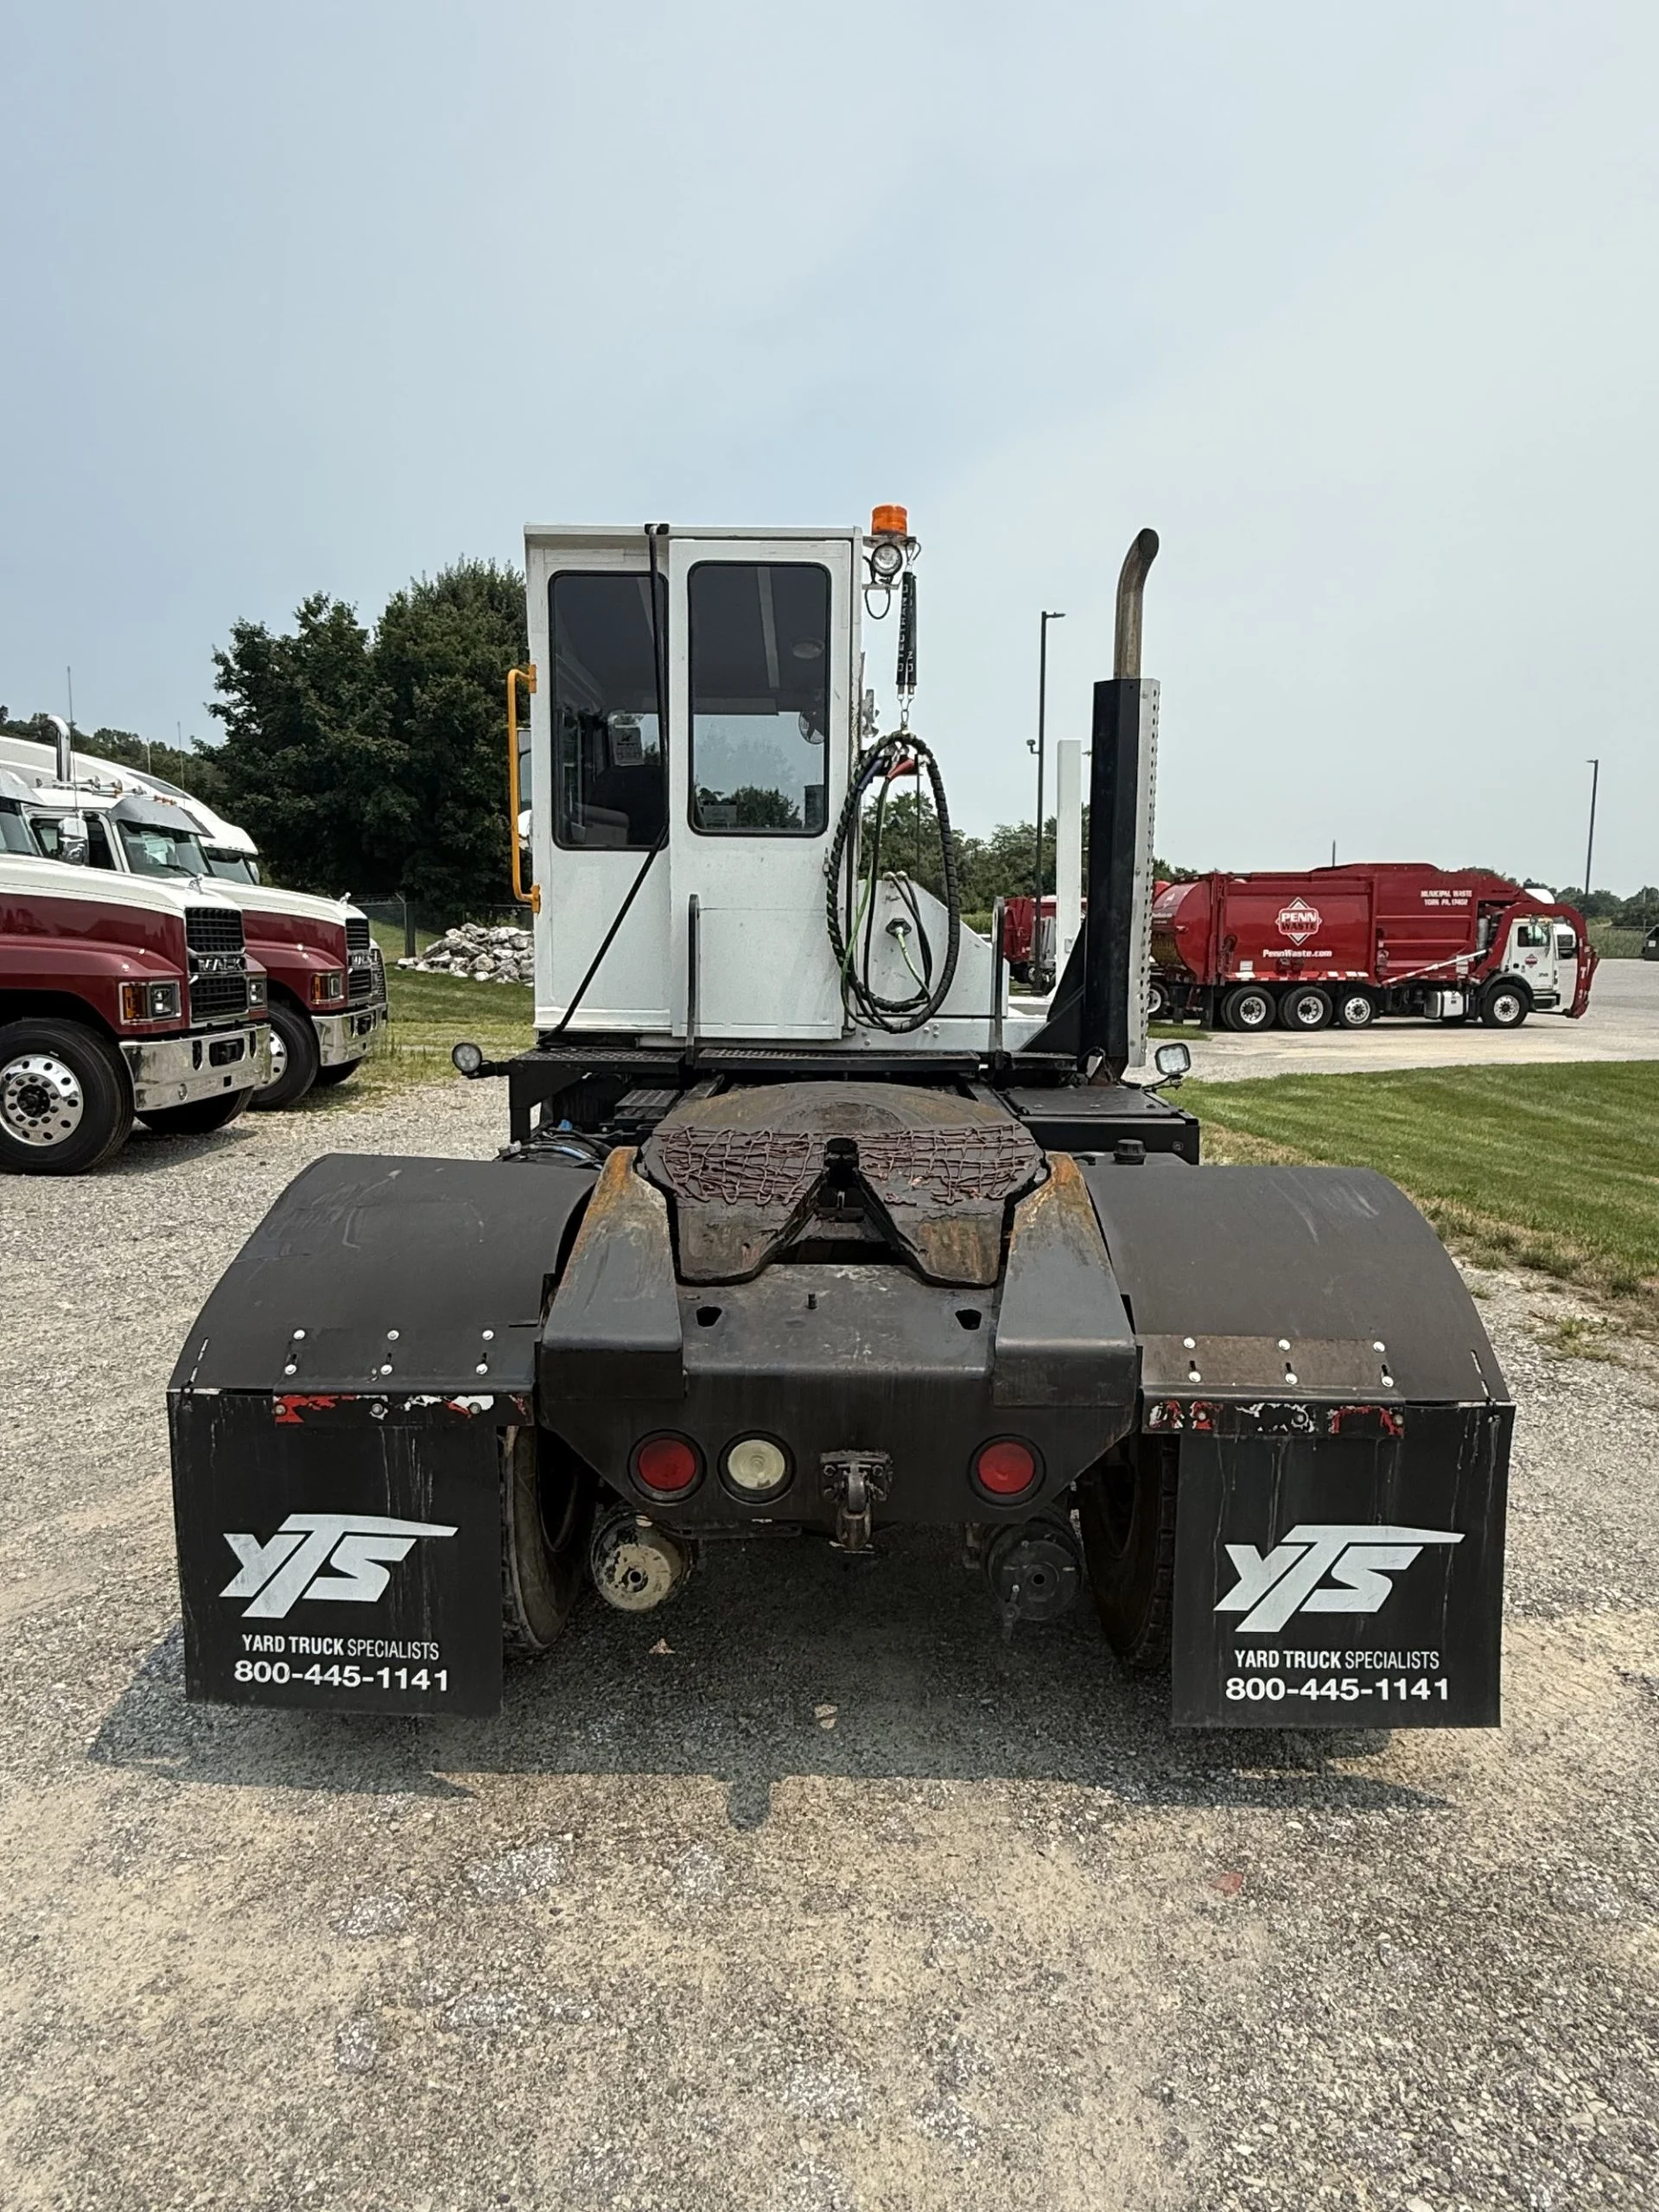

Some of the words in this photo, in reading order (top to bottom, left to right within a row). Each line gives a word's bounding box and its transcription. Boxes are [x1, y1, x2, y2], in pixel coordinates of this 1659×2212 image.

[1281, 912, 1317, 923] PENN
[1281, 922, 1316, 931] WASTE
[1262, 949, 1332, 957] PennWaste.com
[198, 958, 243, 972] MACK
[219, 1514, 459, 1618] YTS
[1213, 1524, 1465, 1633] YTS
[241, 1634, 285, 1653] YARD
[288, 1636, 345, 1656] TRUCK
[347, 1638, 440, 1661] SPECIALISTS
[1234, 1649, 1280, 1669] YARD
[1282, 1649, 1342, 1669] TRUCK
[1344, 1650, 1440, 1670] SPECIALISTS
[233, 1660, 449, 1693] 800-445-1141
[1225, 1677, 1449, 1701] 800-445-1141
